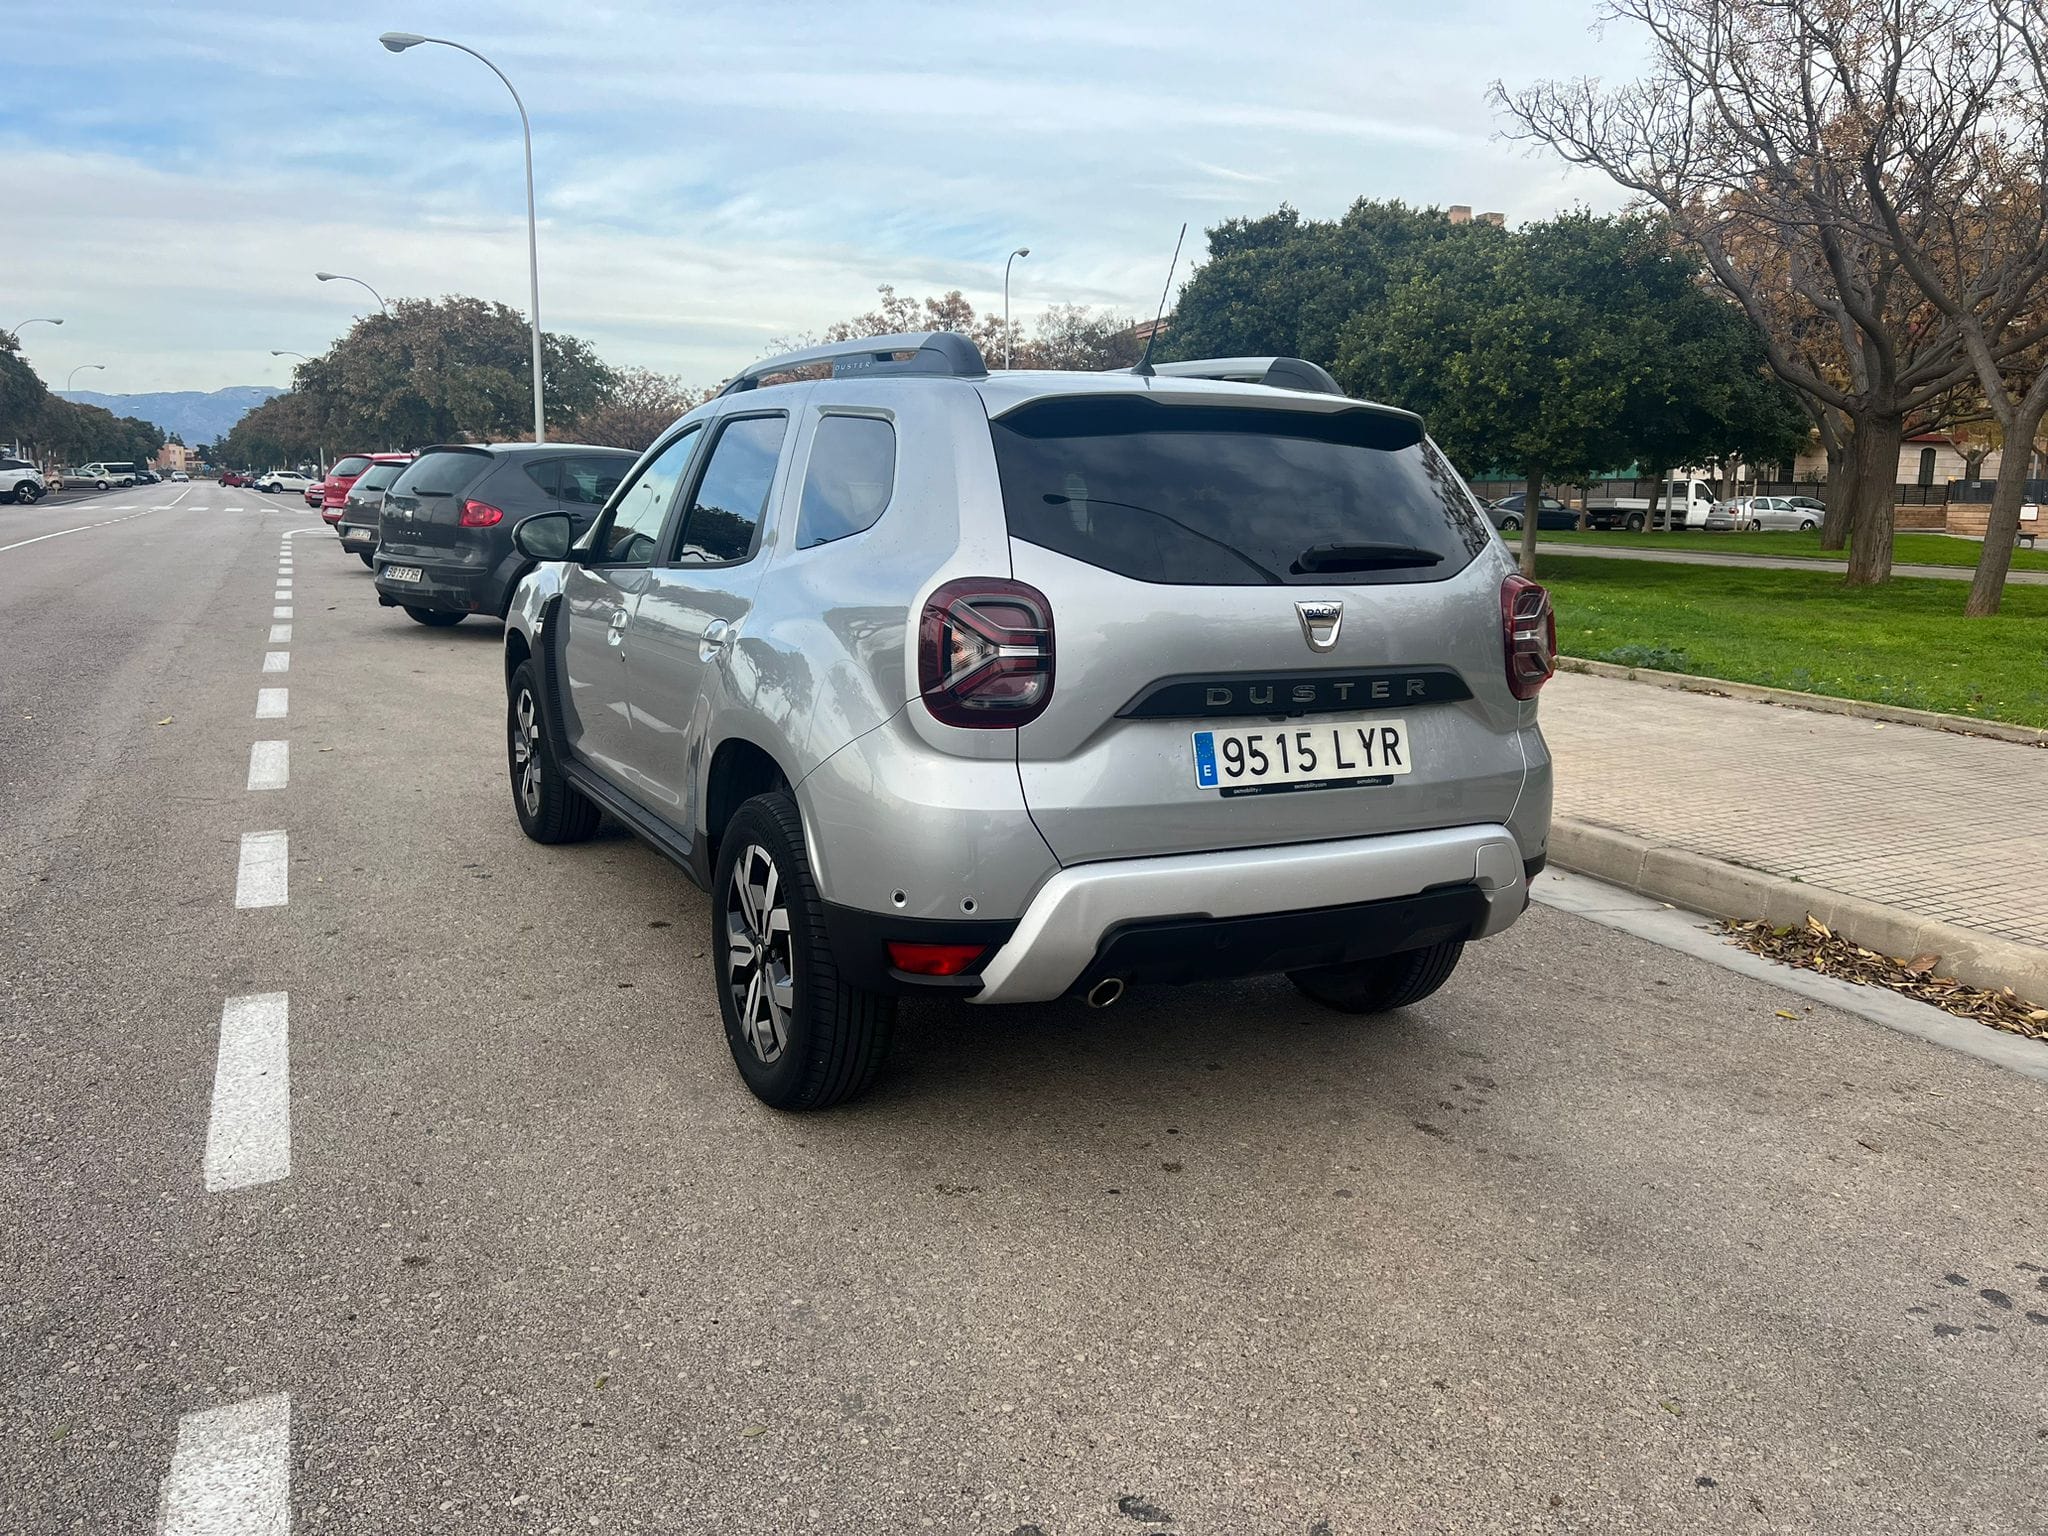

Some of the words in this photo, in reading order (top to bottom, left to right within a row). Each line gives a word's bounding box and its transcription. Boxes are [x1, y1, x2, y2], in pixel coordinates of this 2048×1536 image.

[835, 361, 871, 371] DUSTER
[1306, 608, 1338, 617] DACIA
[1206, 679, 1426, 706] DUSTER
[1222, 732, 1318, 778] 9515
[1333, 726, 1403, 770] LYR
[1203, 764, 1212, 777] E
